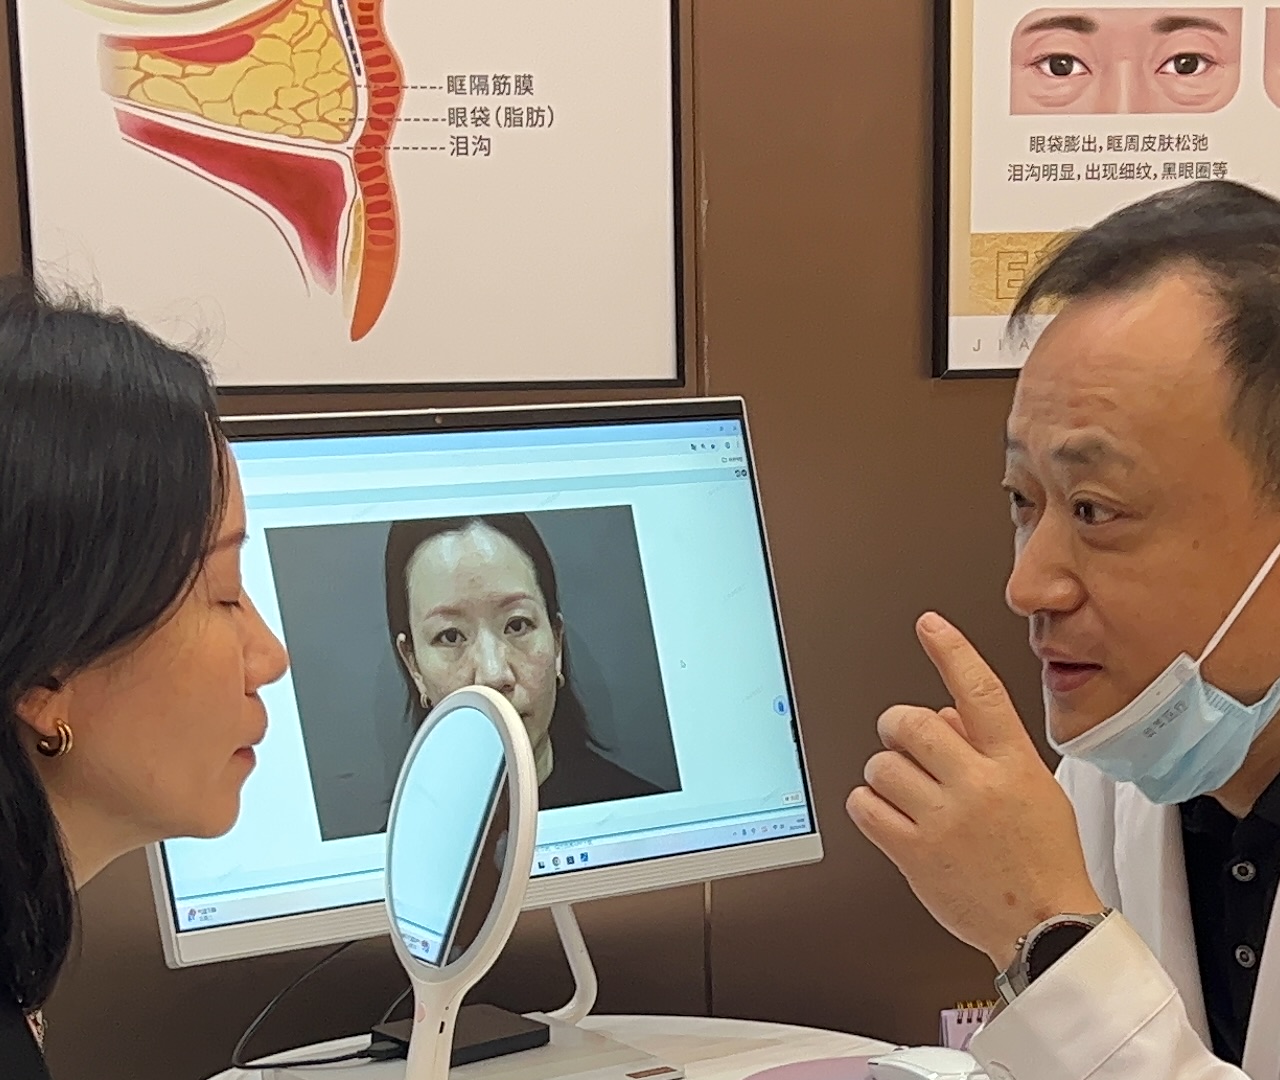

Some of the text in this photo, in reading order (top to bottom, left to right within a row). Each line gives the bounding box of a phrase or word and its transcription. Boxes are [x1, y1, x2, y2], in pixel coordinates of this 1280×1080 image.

[446, 74, 534, 96] 眶隔筋膜
[447, 105, 554, 128] 眼袋（脂肪）
[449, 135, 491, 157] 泪沟
[1029, 133, 1209, 154] 眼袋膨出，眶周皮肤松弛
[1007, 161, 1229, 182] 泪沟明显，出现细纹，黑眼圈等
